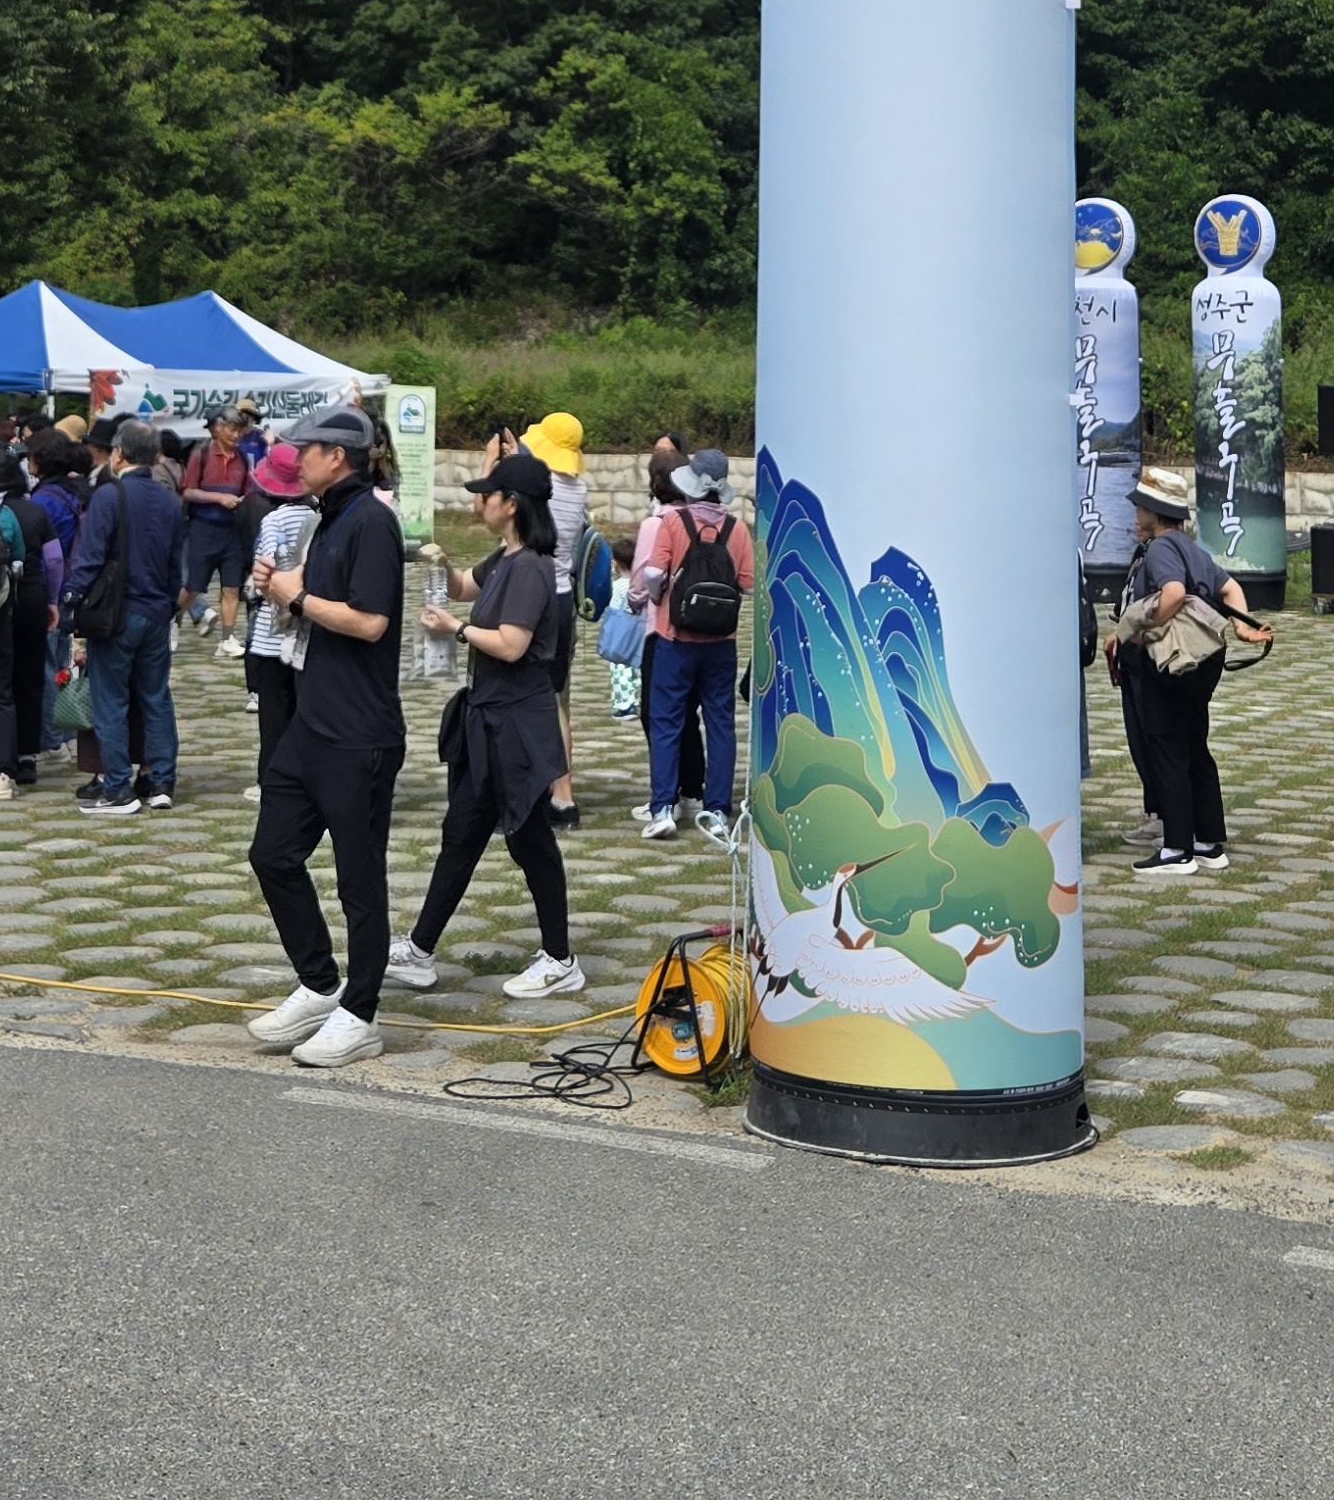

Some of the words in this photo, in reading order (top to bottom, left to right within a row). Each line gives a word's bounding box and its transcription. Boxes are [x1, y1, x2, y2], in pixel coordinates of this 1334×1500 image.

[1075, 295, 1117, 325] 천시
[1196, 290, 1254, 323] 성주군
[1206, 330, 1247, 556] 무흘구곡
